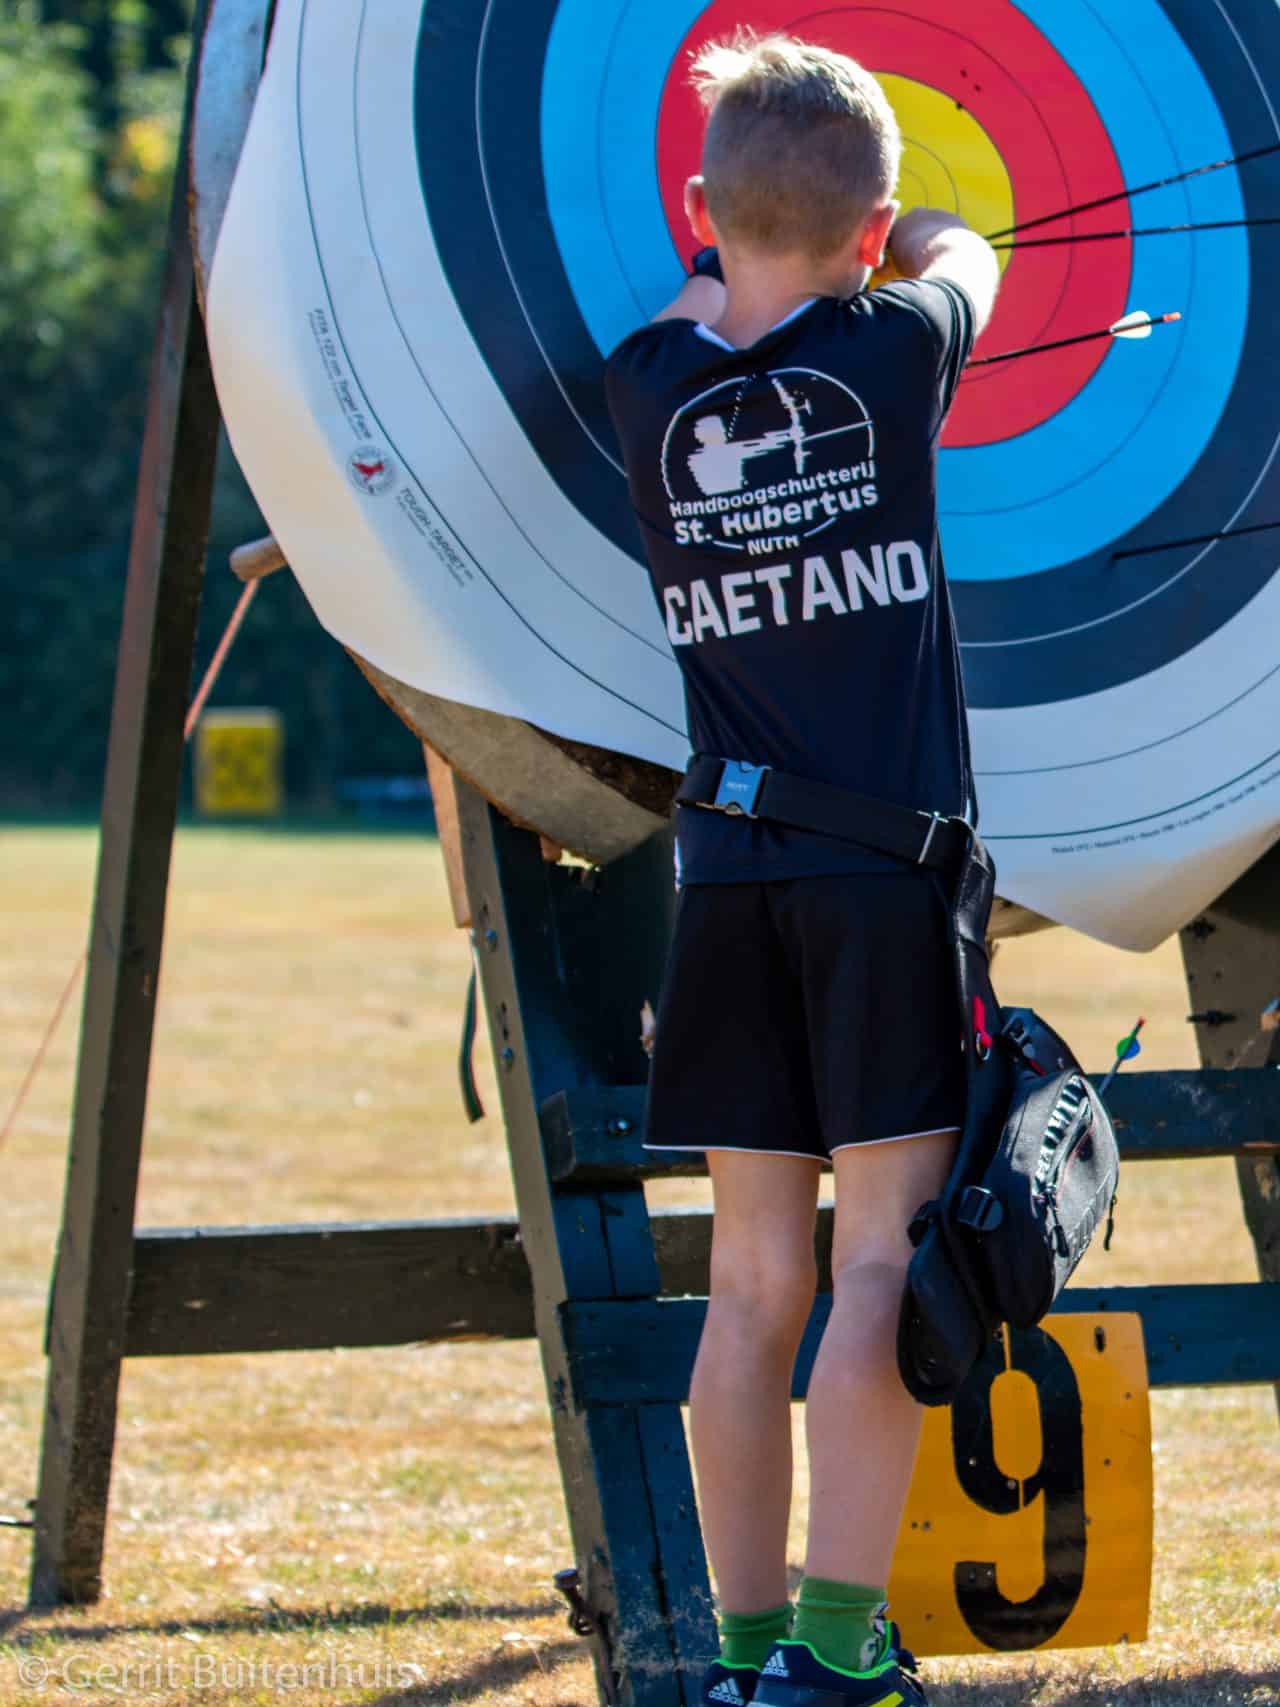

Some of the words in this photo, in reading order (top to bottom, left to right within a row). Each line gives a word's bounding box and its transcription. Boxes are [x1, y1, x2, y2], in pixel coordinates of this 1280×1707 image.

[669, 460, 876, 518] Handboogschutterij
[674, 518, 713, 545] St.
[721, 484, 879, 537] Hubertus
[747, 534, 800, 556] NUTH
[663, 540, 930, 647] CAETANO
[951, 1321, 1088, 1651] 9
